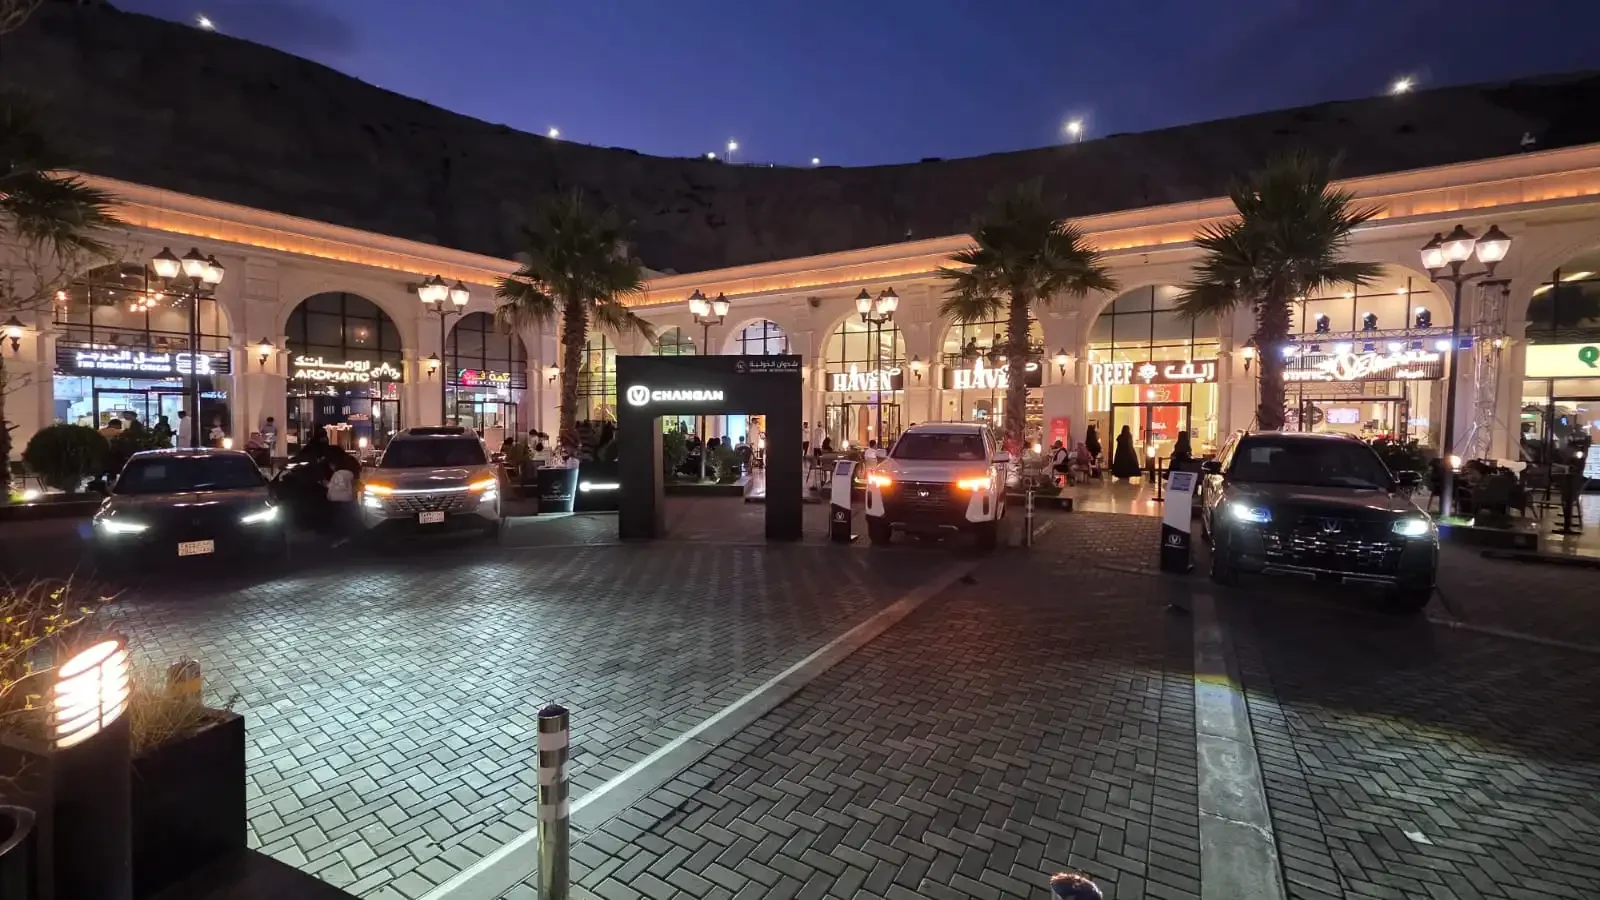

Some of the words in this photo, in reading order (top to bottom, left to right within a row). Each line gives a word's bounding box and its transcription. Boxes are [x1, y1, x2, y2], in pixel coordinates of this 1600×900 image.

[294, 369, 371, 382] AROMATIC
[833, 365, 894, 392] HAVEN
[952, 359, 1010, 390] HAVE
[1092, 362, 1134, 385] REEF
[1164, 361, 1215, 383] ريف
[651, 389, 724, 401] CHANGAN
